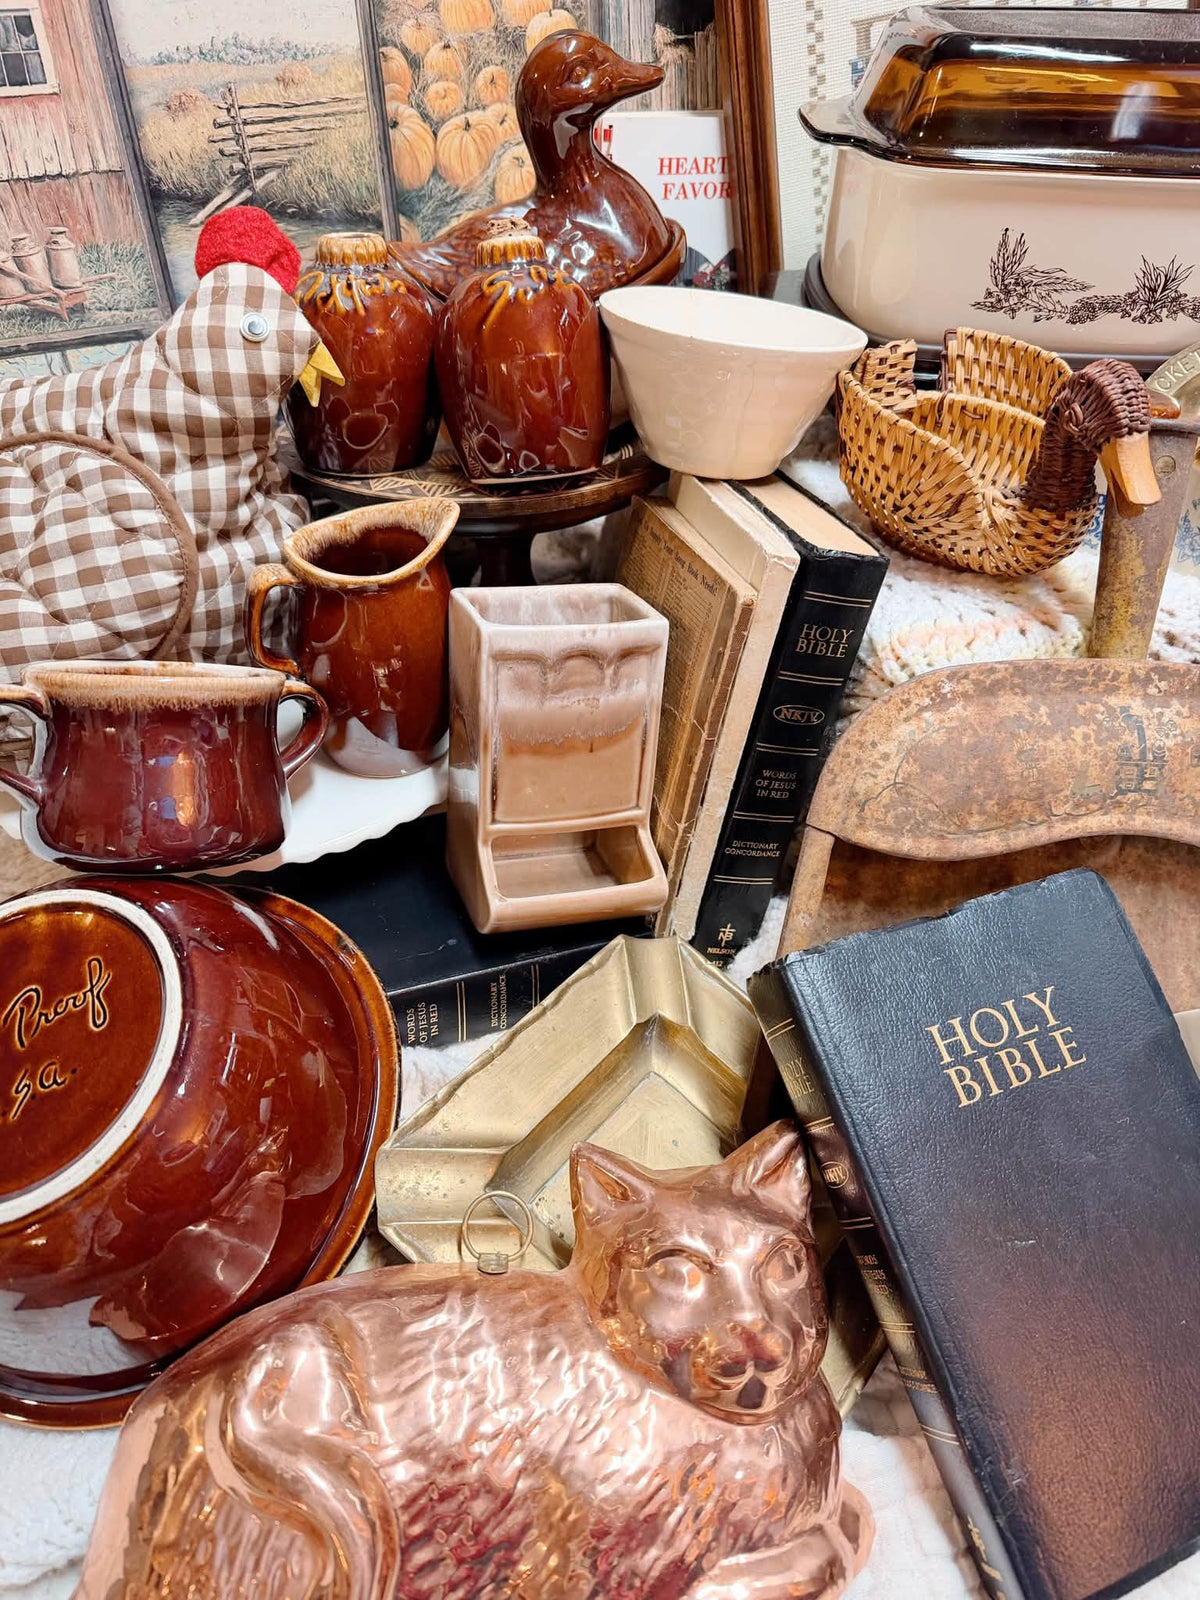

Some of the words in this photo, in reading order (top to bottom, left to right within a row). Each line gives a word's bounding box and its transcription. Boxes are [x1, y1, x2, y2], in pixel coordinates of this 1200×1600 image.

[658, 156, 729, 176] HEART
[662, 181, 736, 201] FAVOR
[800, 623, 854, 644] HOLY
[795, 637, 848, 658] BIBLE
[755, 779, 769, 788] OF
[770, 781, 796, 789] JESUS
[762, 770, 797, 779] WORDS
[756, 789, 769, 798] IN
[770, 790, 789, 798] RED
[724, 847, 781, 858] CONCORDANCE
[732, 840, 779, 850] DICTIONARY
[707, 947, 736, 955] NELSON
[2, 957, 112, 1048] Proof
[490, 982, 498, 1027] DICTIONARY
[499, 974, 508, 1030] CONCORDANCE
[417, 1002, 429, 1028] JESUS
[429, 1003, 439, 1023] RED
[406, 1008, 416, 1044] WORDS
[430, 1024, 439, 1037] IN
[925, 985, 1060, 1065] HOLY
[418, 1028, 428, 1043] OF
[943, 1026, 1087, 1108] BIBLE
